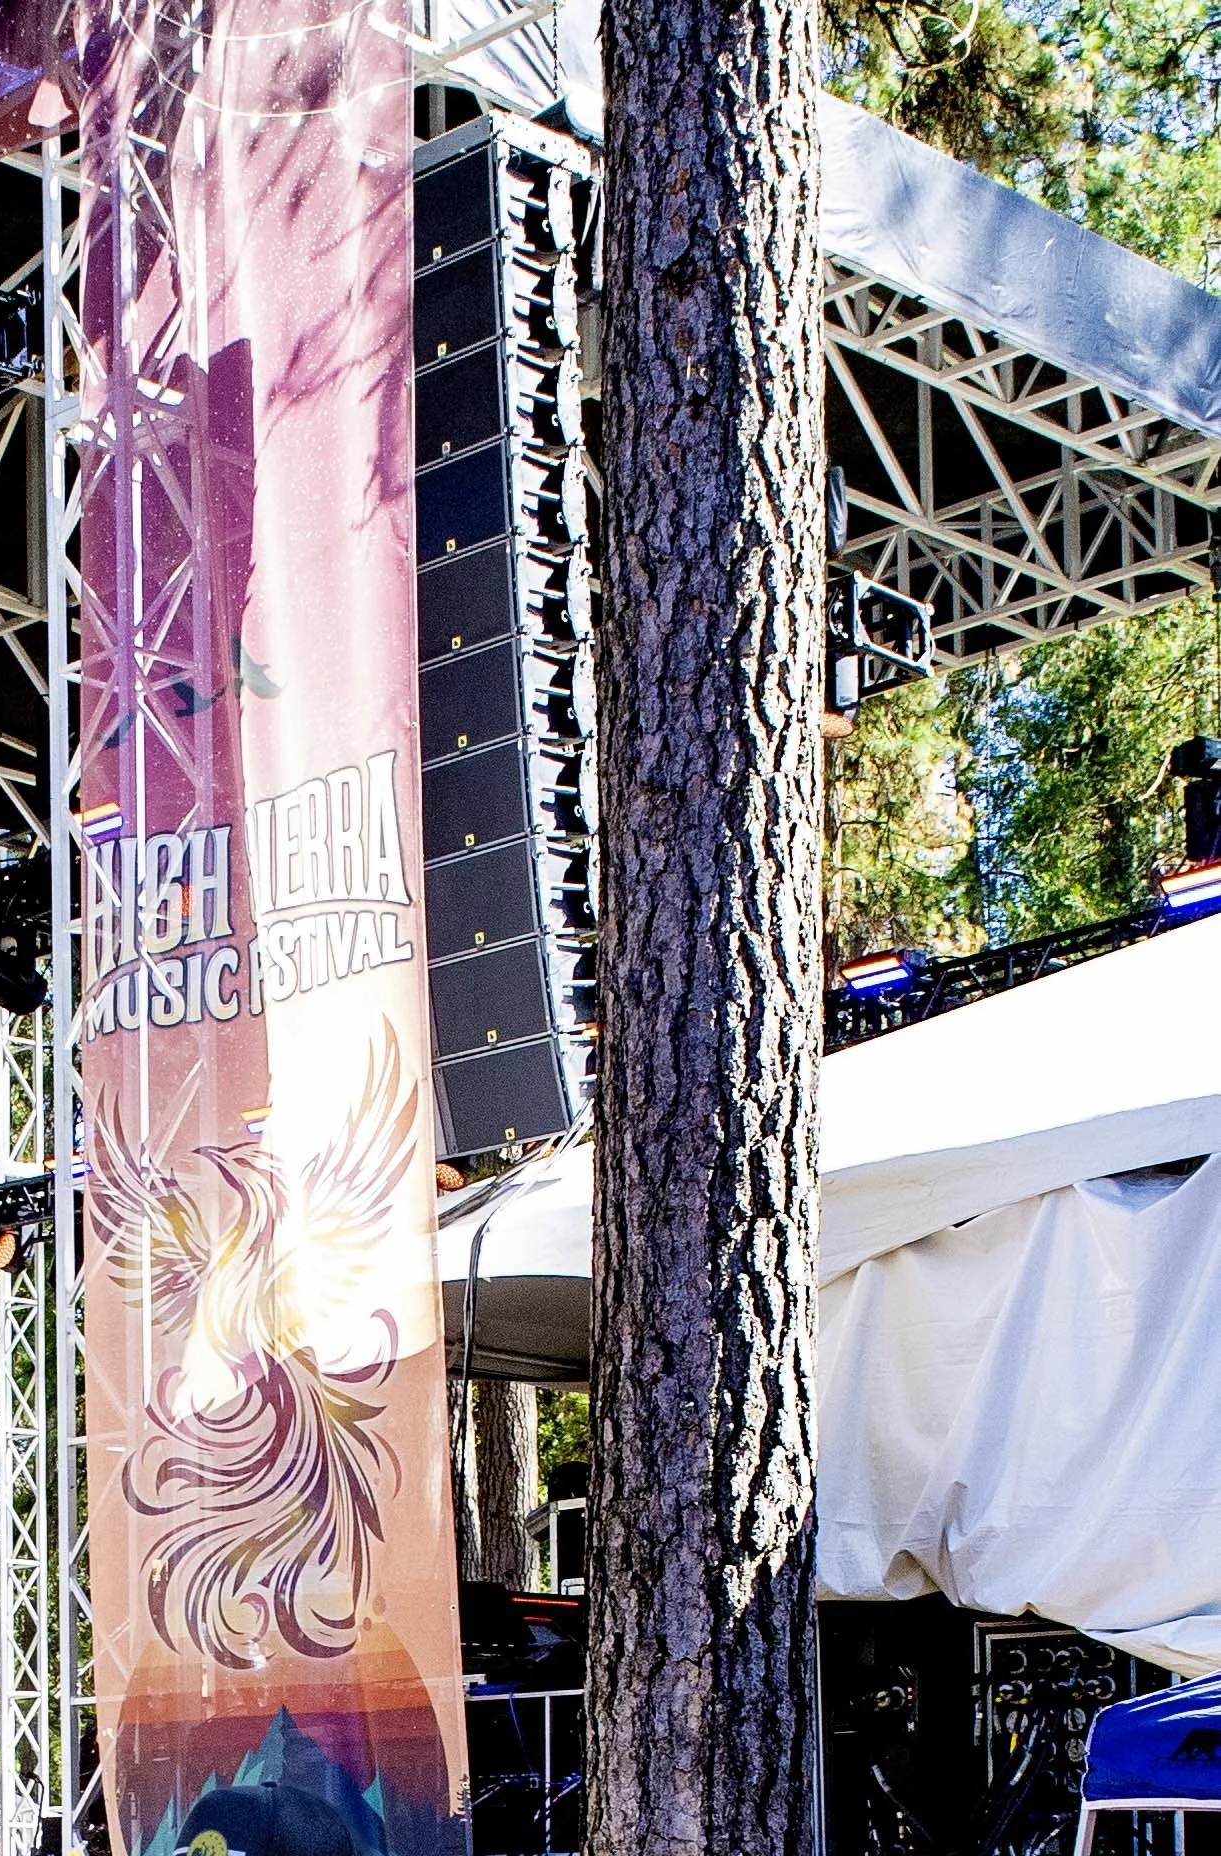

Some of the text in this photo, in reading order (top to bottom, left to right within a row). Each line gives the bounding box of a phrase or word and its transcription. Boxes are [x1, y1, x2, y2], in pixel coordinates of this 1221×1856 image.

[85, 824, 234, 992] HIGH
[86, 909, 414, 1043] MUSIC FSTIVAL
